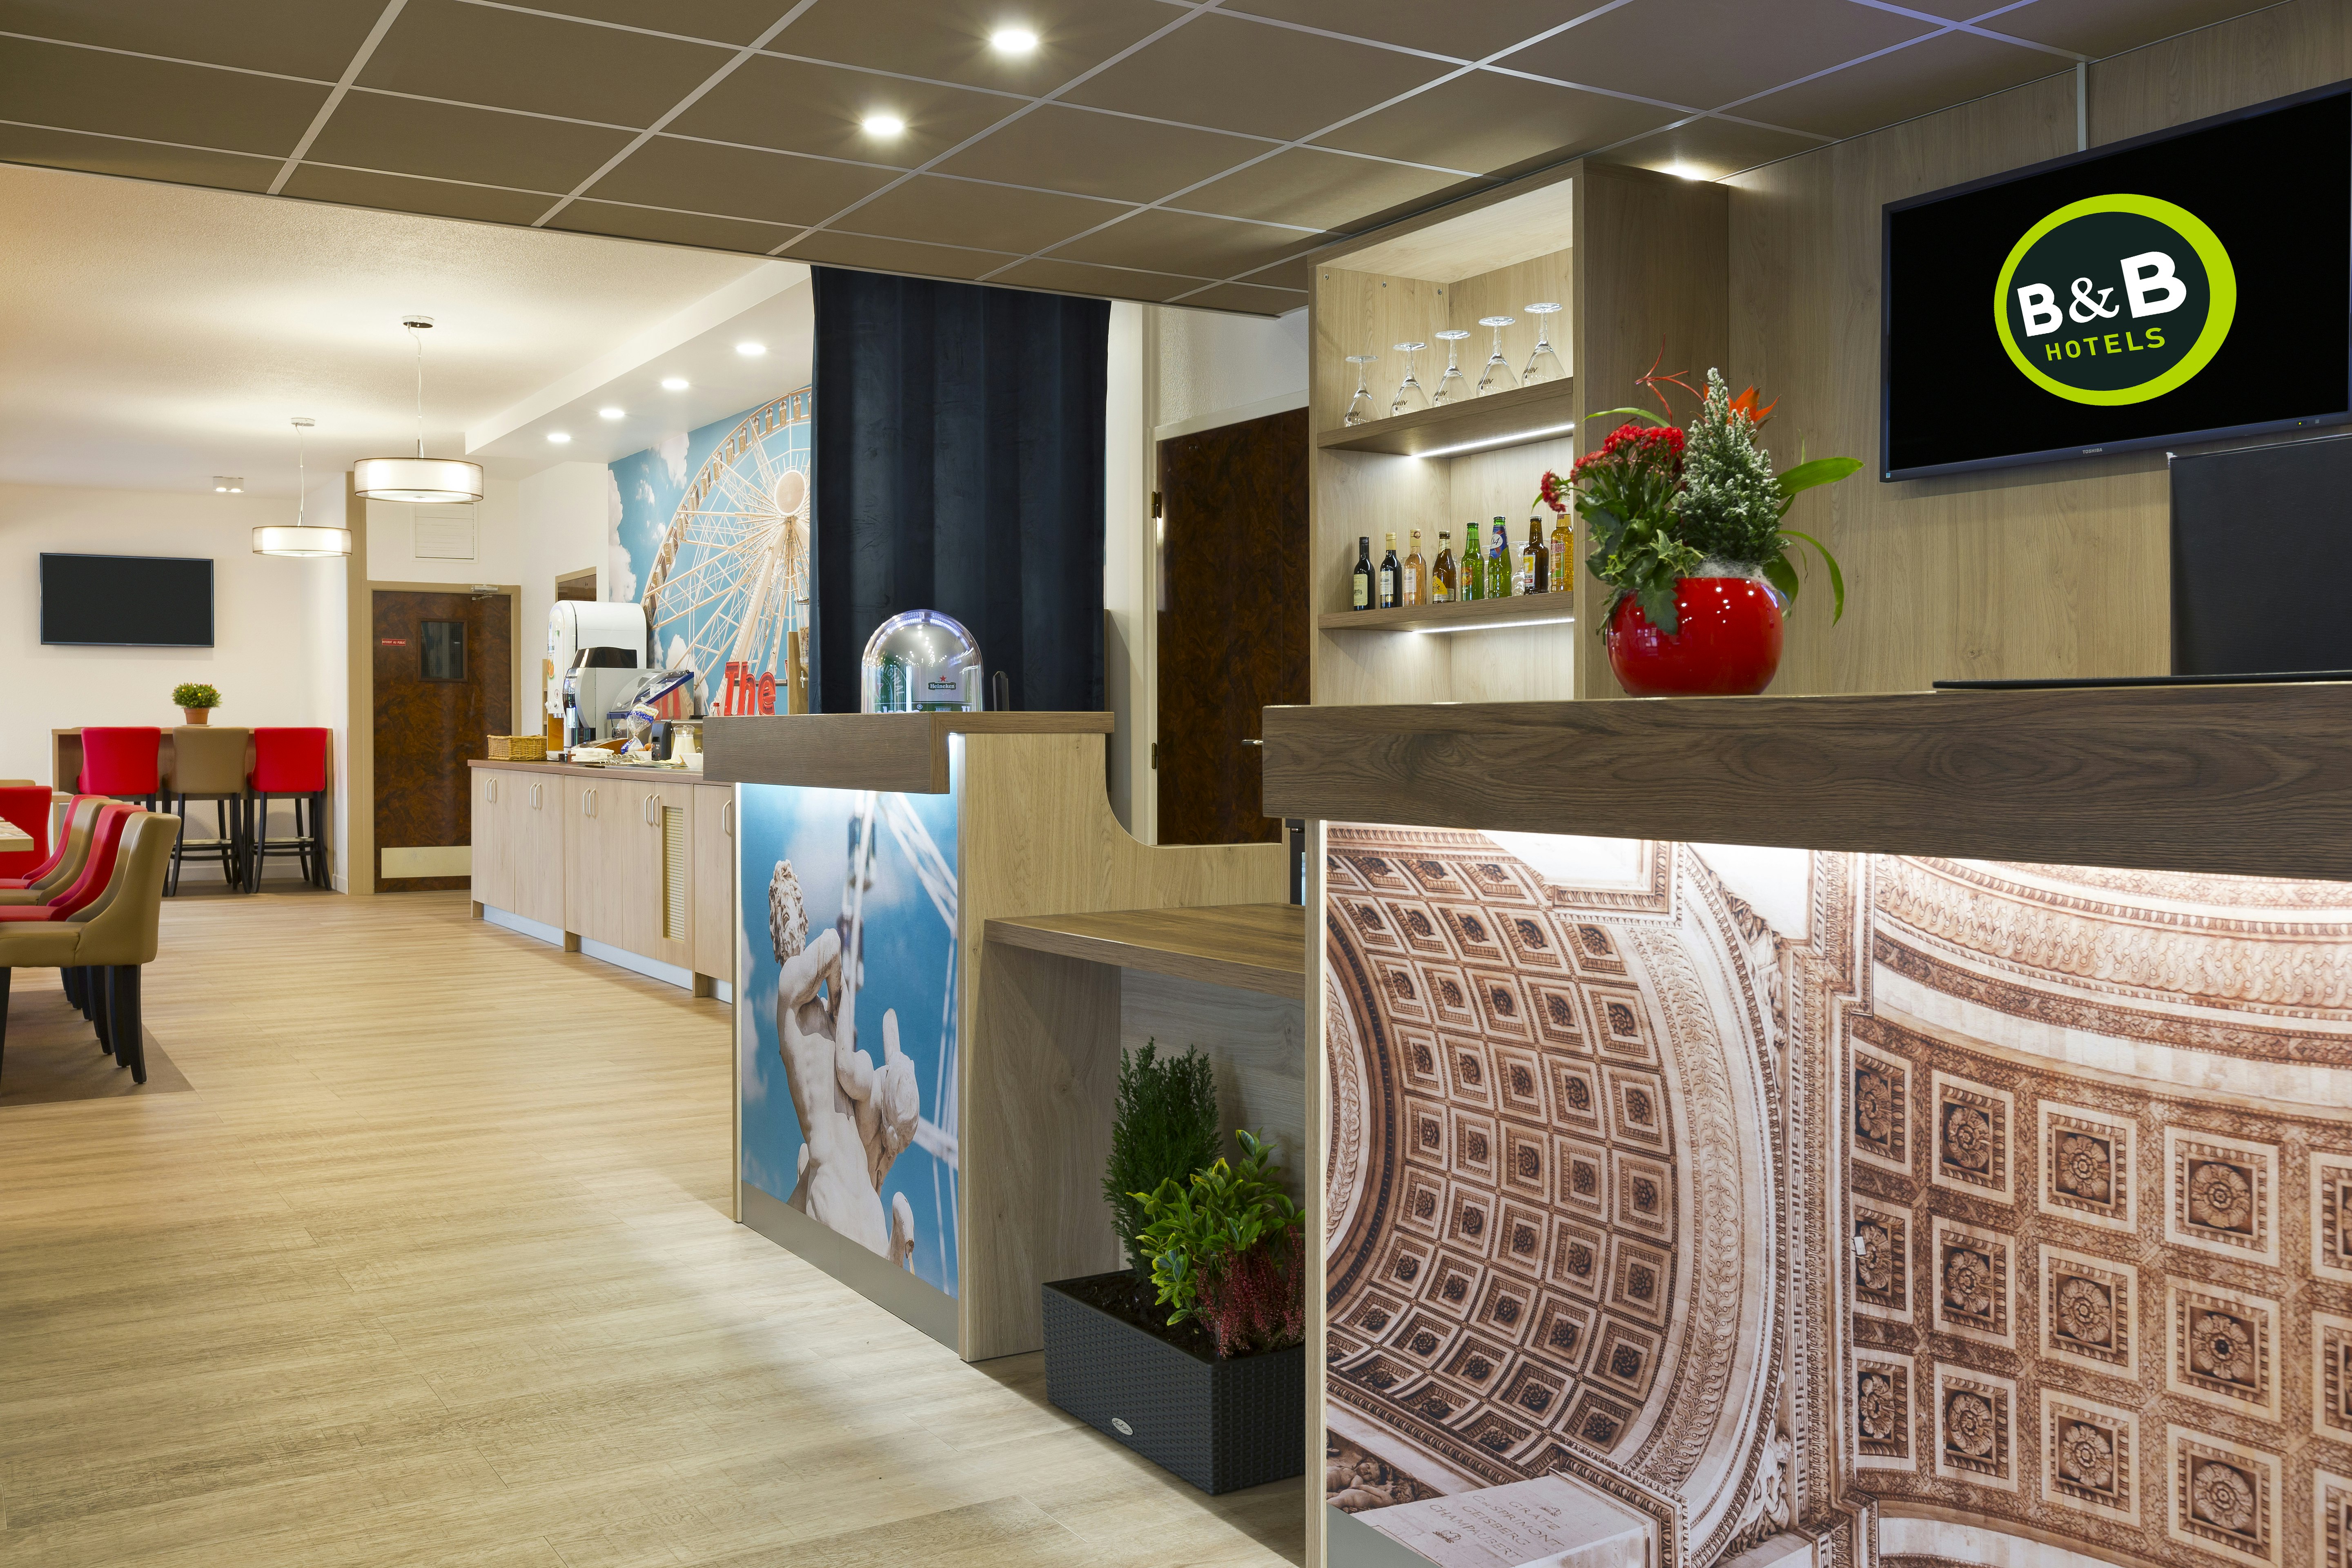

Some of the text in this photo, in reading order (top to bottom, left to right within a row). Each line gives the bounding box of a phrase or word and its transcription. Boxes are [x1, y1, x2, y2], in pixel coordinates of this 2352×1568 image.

[2017, 252, 2187, 337] B&B
[2045, 327, 2165, 361] HOTELS
[724, 661, 776, 716] The
[1429, 1504, 1523, 1559] CHAMPAUBERT
[1462, 1506, 1531, 1546] GEISBERG
